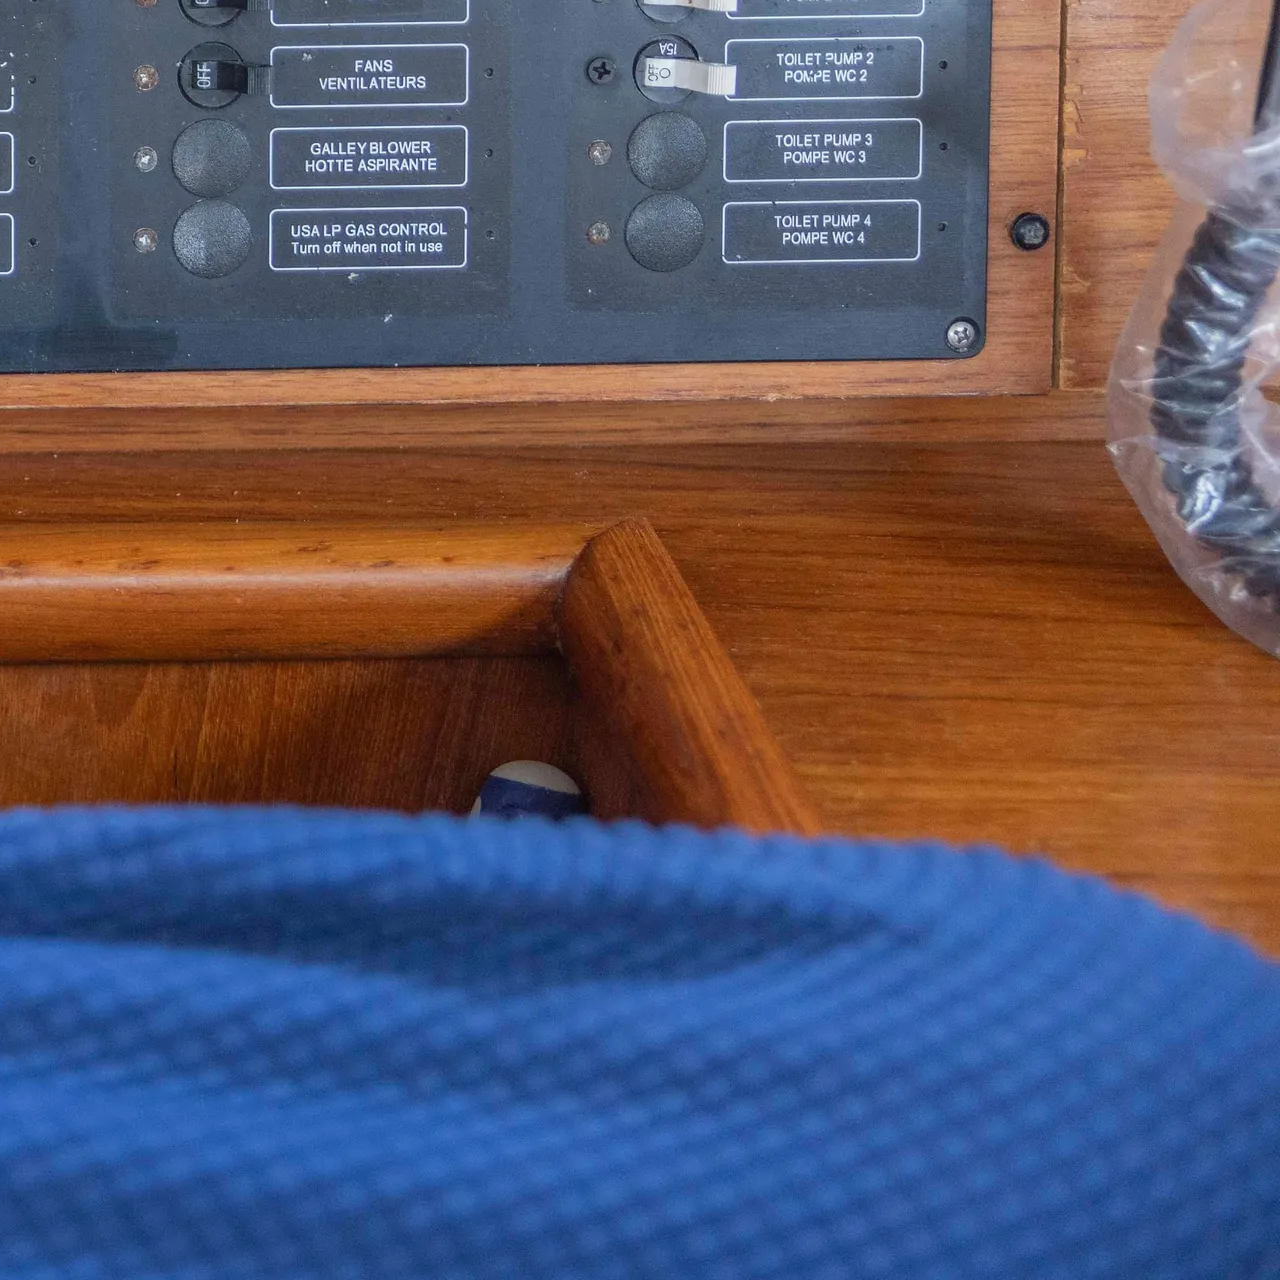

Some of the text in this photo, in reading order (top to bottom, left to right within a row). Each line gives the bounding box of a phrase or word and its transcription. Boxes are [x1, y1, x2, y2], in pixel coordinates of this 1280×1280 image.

[355, 60, 392, 72] FANS
[319, 76, 426, 89] VENTILATEURS
[292, 223, 447, 237] USA LP GAS CONTROL
